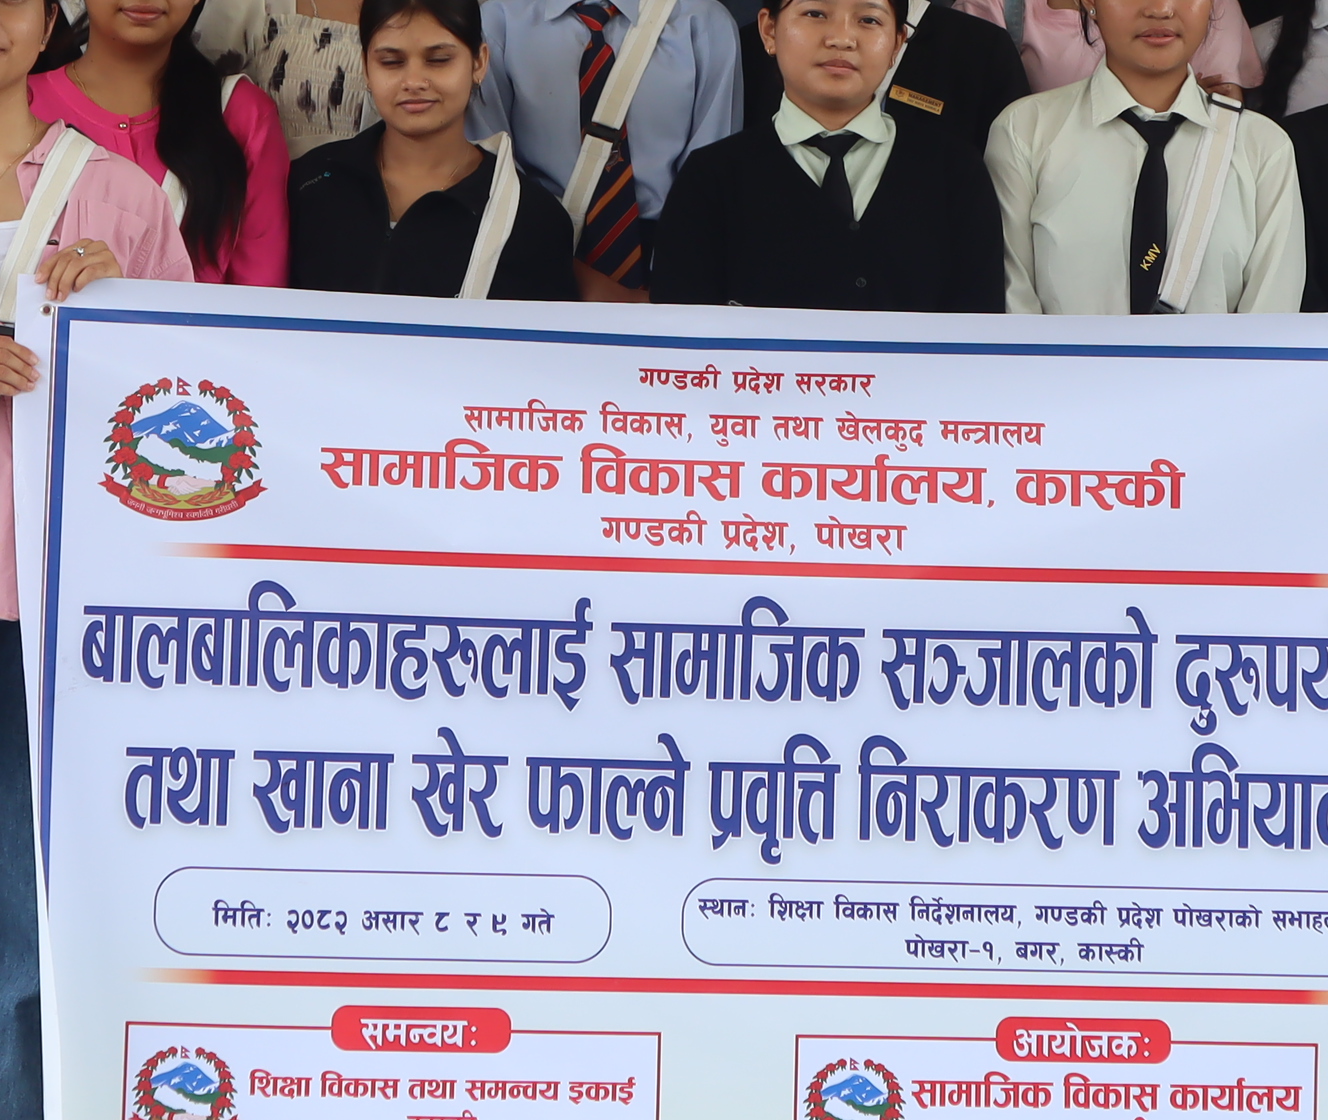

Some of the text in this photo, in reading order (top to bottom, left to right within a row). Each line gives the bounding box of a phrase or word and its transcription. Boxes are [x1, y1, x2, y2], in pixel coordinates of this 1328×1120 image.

[1139, 243, 1161, 271] KMV
[638, 364, 876, 397] गण्डकी प्रदेश सरकार
[463, 398, 1046, 452] सामाजिक विकास, युवा तथा खेलकुद मन्त्रालय
[320, 437, 1186, 511] सामाजिक विकास कार्यालय, कास्की
[600, 509, 908, 556] गण्डकी प्रदेश, पोखरा
[610, 597, 866, 705] सामाजिक
[881, 606, 1159, 712] सञ्जालको
[124, 746, 236, 830] तथा
[253, 750, 395, 834] खाना
[412, 727, 509, 837] खेर
[526, 733, 692, 841] फाल्ने
[709, 734, 842, 864] प्रवृत्ति
[858, 736, 1121, 850] निराकरण
[286, 909, 348, 935] २०८२
[362, 910, 424, 936] असार
[464, 912, 482, 937] र
[520, 908, 555, 935] गते
[768, 893, 825, 922] शिक्षा
[833, 894, 900, 923] विकास
[1035, 900, 1108, 927] गण्डकी
[1117, 901, 1164, 930] प्रदेश
[1173, 903, 1263, 932] पोखराको
[1015, 941, 1065, 966] बगर,
[1077, 937, 1145, 964] कास्की
[249, 1069, 636, 1105] शिक्षा विकास तथा समन्वय इकाई
[912, 1071, 1303, 1114] सामाजिक विकास कार्यालय
